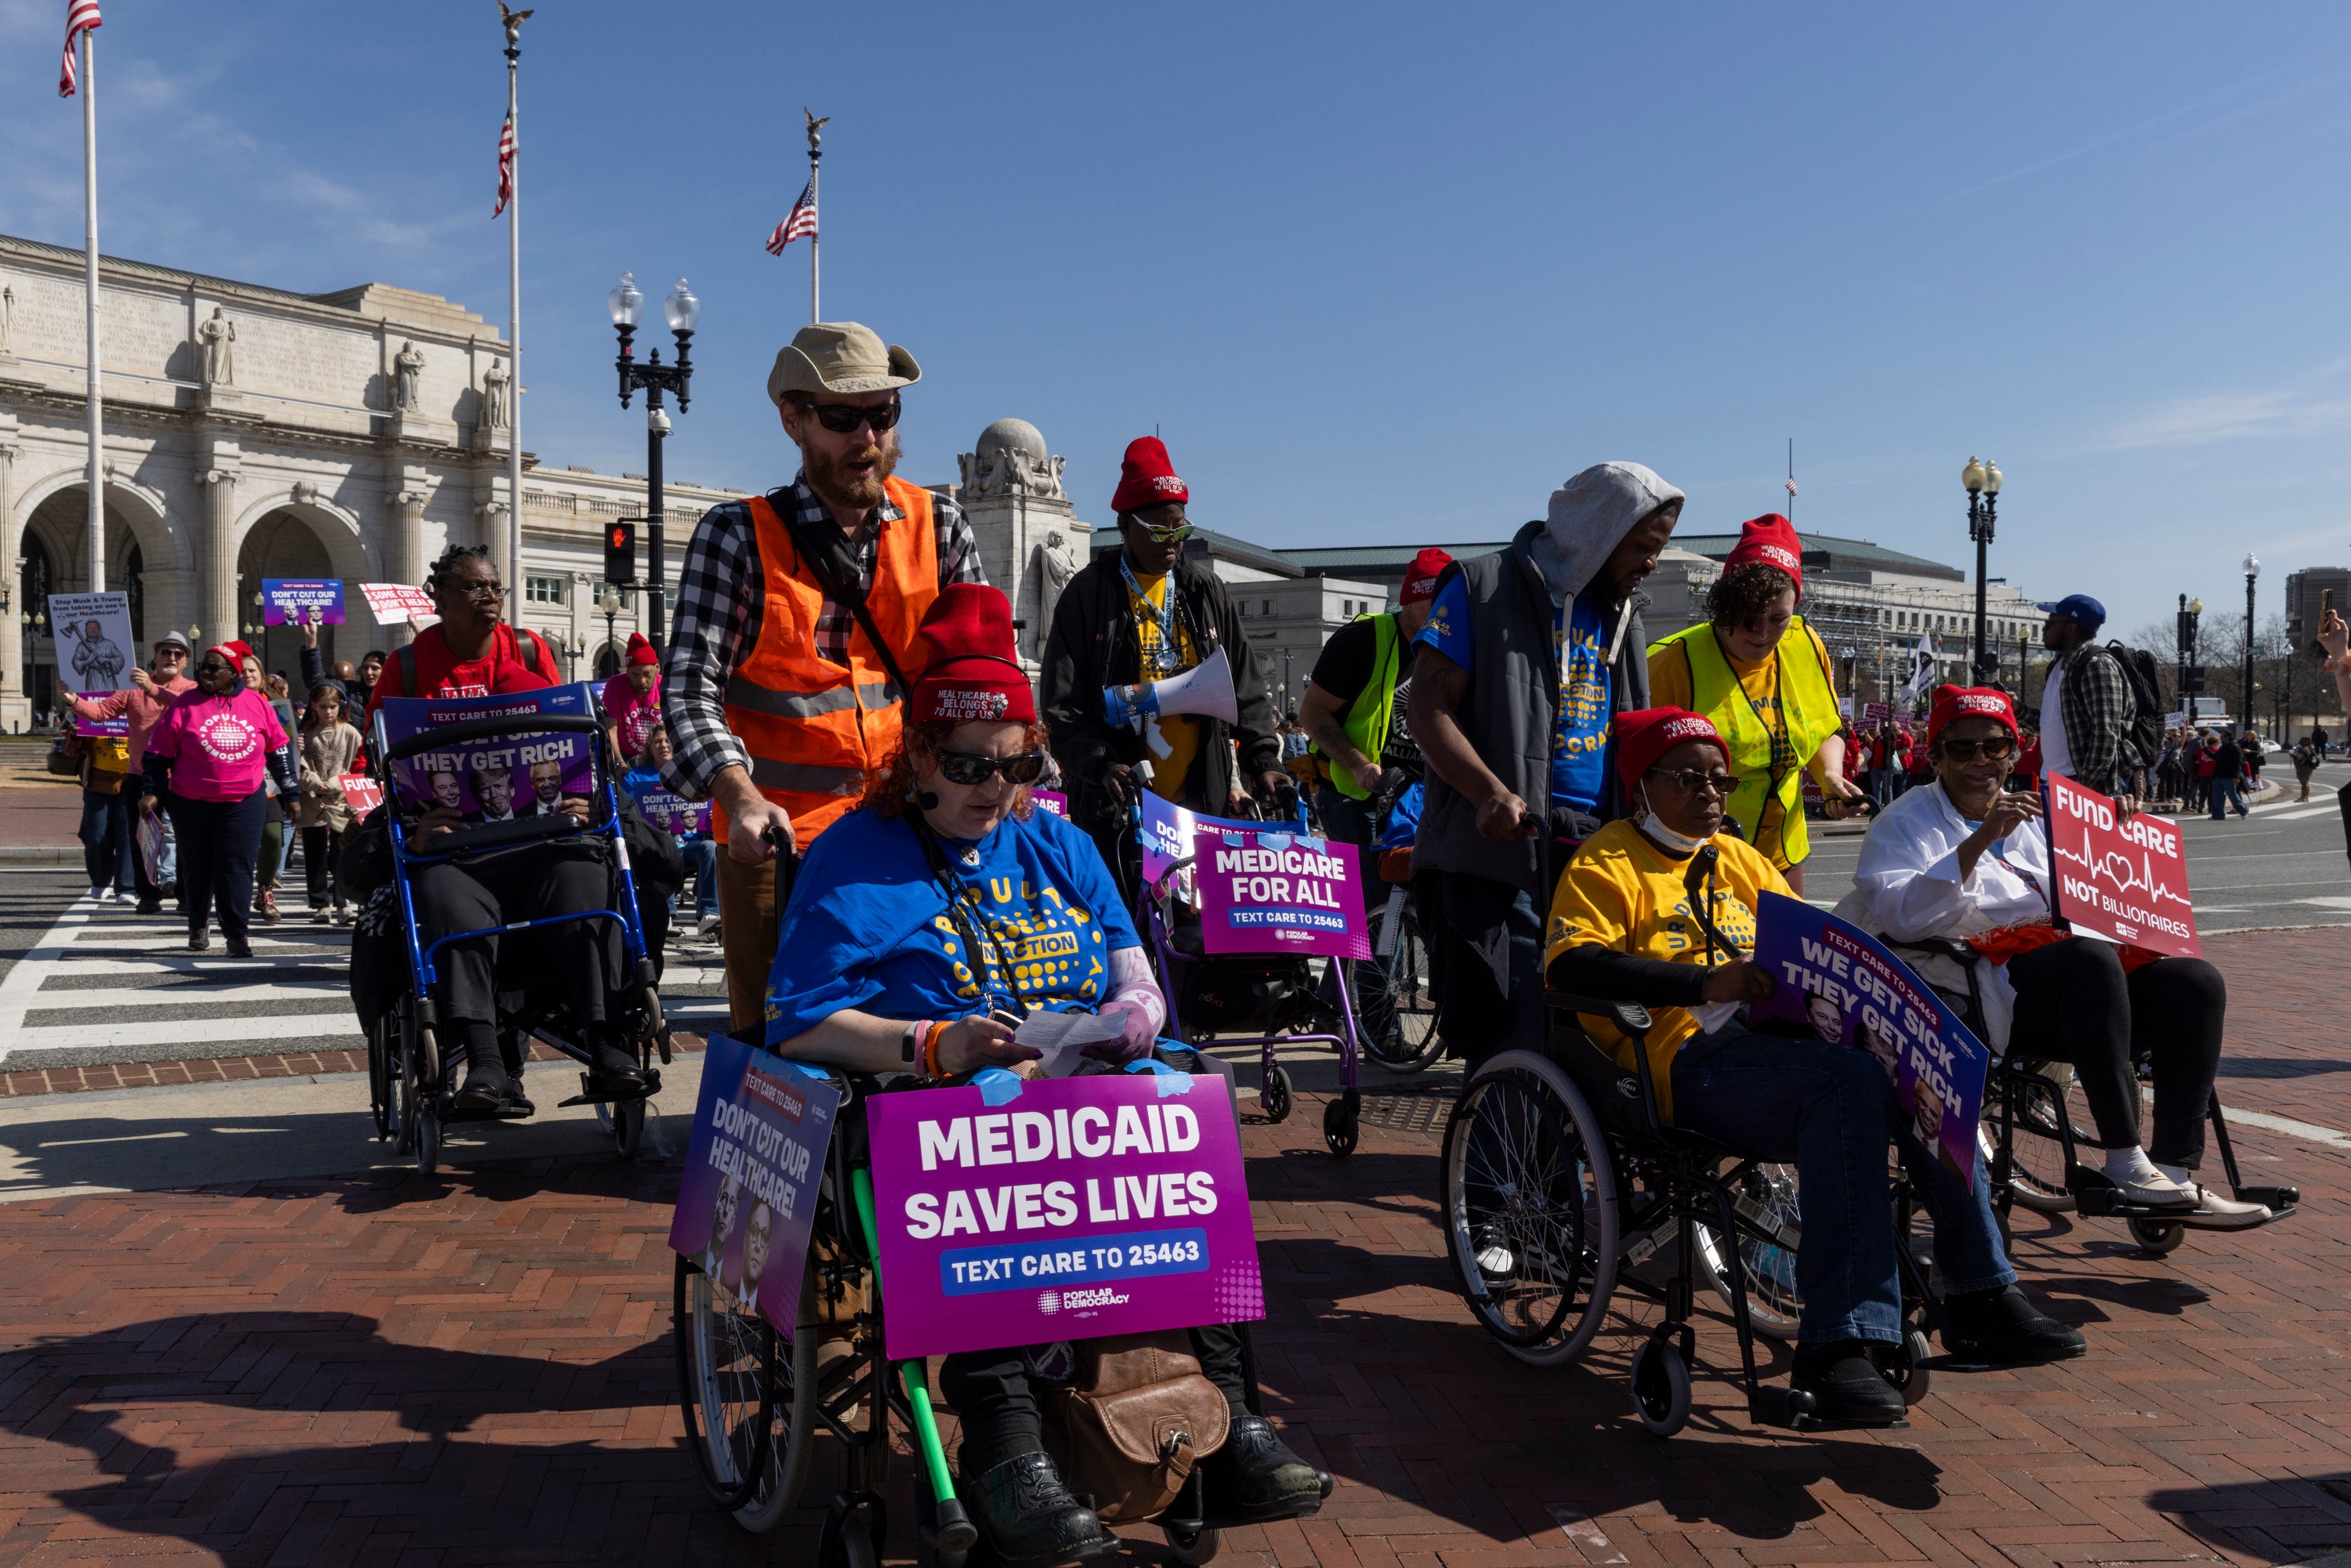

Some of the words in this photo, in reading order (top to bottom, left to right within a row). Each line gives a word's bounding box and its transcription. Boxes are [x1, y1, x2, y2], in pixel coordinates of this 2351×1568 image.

[1126, 574, 1136, 586] NC
[271, 590, 298, 599] DON'T
[299, 590, 316, 599] CUT
[317, 590, 335, 599] OUR
[372, 590, 397, 599] SOME
[397, 589, 416, 598] CUTS
[1166, 587, 1172, 596] NC
[274, 598, 332, 607] HEALTHCARE!
[380, 598, 405, 609] DON'T
[406, 597, 429, 607] HEAL
[79, 609, 119, 617] Healthcare!
[1559, 684, 1603, 699] ACTION
[944, 698, 988, 710] BELONGS
[432, 712, 457, 722] TEXT
[459, 711, 487, 721] CARE
[625, 707, 664, 724] POPULA
[934, 707, 945, 716] TO
[946, 708, 962, 718] ALL
[965, 710, 976, 719] OF
[979, 710, 994, 720] US
[200, 713, 255, 733] POPULAR
[201, 739, 257, 760] DEMOCRACY
[1390, 737, 1415, 748] Maine
[411, 751, 465, 772] THEY
[471, 748, 517, 770] GET
[520, 738, 574, 766] RICH
[1383, 744, 1425, 762] ALLIAN
[643, 795, 672, 805] DON'T
[646, 801, 708, 813] HEALTHCARE!
[1197, 824, 1219, 835] CARE
[2056, 784, 2114, 832] FUND
[2118, 819, 2178, 859] CARE
[1215, 849, 1346, 882] MEDICARE
[1232, 877, 1291, 903] FOR
[1295, 879, 1341, 908] ALL
[2063, 874, 2099, 907] NOT
[2102, 895, 2190, 939] BILLIONAIRES
[1233, 912, 1264, 923] TEXT
[1266, 912, 1297, 923] CARE
[1298, 913, 1312, 925] TO
[1313, 915, 1344, 929] 25463
[1005, 935, 1075, 961] ACTION
[1828, 930, 1860, 954] TEXT
[1861, 949, 1891, 978] CARE
[1892, 975, 1906, 993] TO
[1907, 989, 1937, 1026] 25463
[1801, 936, 1849, 980] WE
[1853, 965, 1902, 1016] GET
[1904, 1006, 1957, 1077] SICK
[1781, 960, 1860, 1013] THEY
[1861, 1003, 1908, 1056] GET
[1910, 1045, 1962, 1118] RICH
[746, 1073, 762, 1094] TEXT
[761, 1082, 776, 1102] CARE
[776, 1090, 783, 1106] TO
[783, 1095, 802, 1118] 25463
[712, 1097, 760, 1146] DON'T
[756, 1122, 784, 1164] CUT
[780, 1138, 810, 1185] OUR
[917, 1103, 1200, 1172] MEDICAID
[708, 1135, 797, 1221] HEALTHCARE!
[904, 1180, 1078, 1240] SAVES
[1085, 1171, 1218, 1223] LIVES
[951, 1257, 1014, 1284] TEXT
[1020, 1251, 1087, 1277] CARE
[1092, 1247, 1123, 1270] TO
[1128, 1240, 1200, 1267] 25463
[1063, 1287, 1113, 1301] POPULAR
[1063, 1294, 1130, 1310] DEMOCRACY
